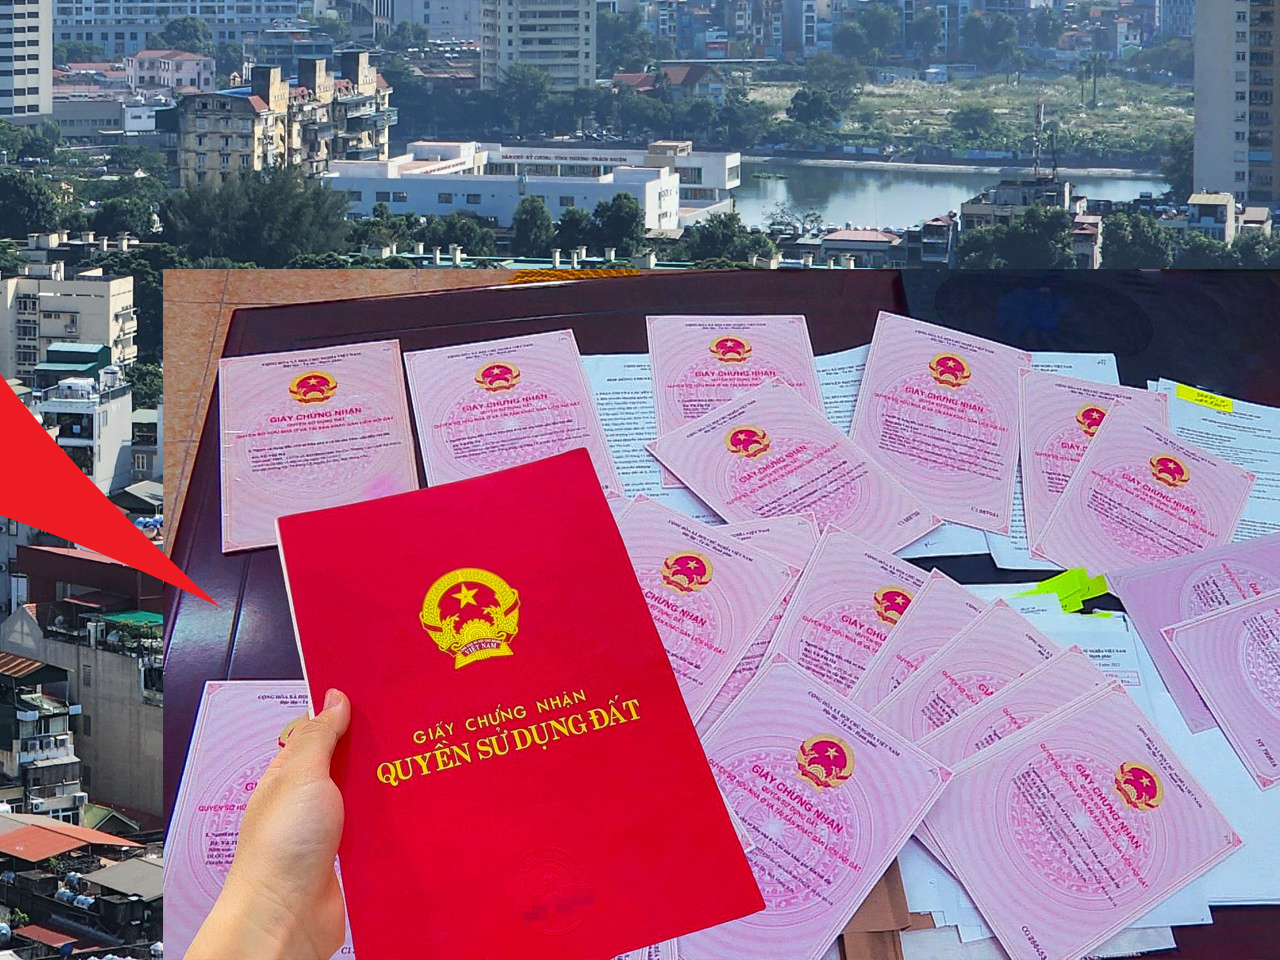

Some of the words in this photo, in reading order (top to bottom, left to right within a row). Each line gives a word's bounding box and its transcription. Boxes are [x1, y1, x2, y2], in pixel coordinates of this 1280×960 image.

[481, 642, 497, 650] NAM
[376, 740, 472, 786] QUYỀN
[476, 727, 510, 760] SỬ
[510, 714, 587, 750] DỤNG
[587, 695, 641, 731] ĐẤT
[413, 721, 454, 744] GIẤY
[465, 704, 527, 731] CHỨNG
[536, 689, 587, 713] NHẬN
